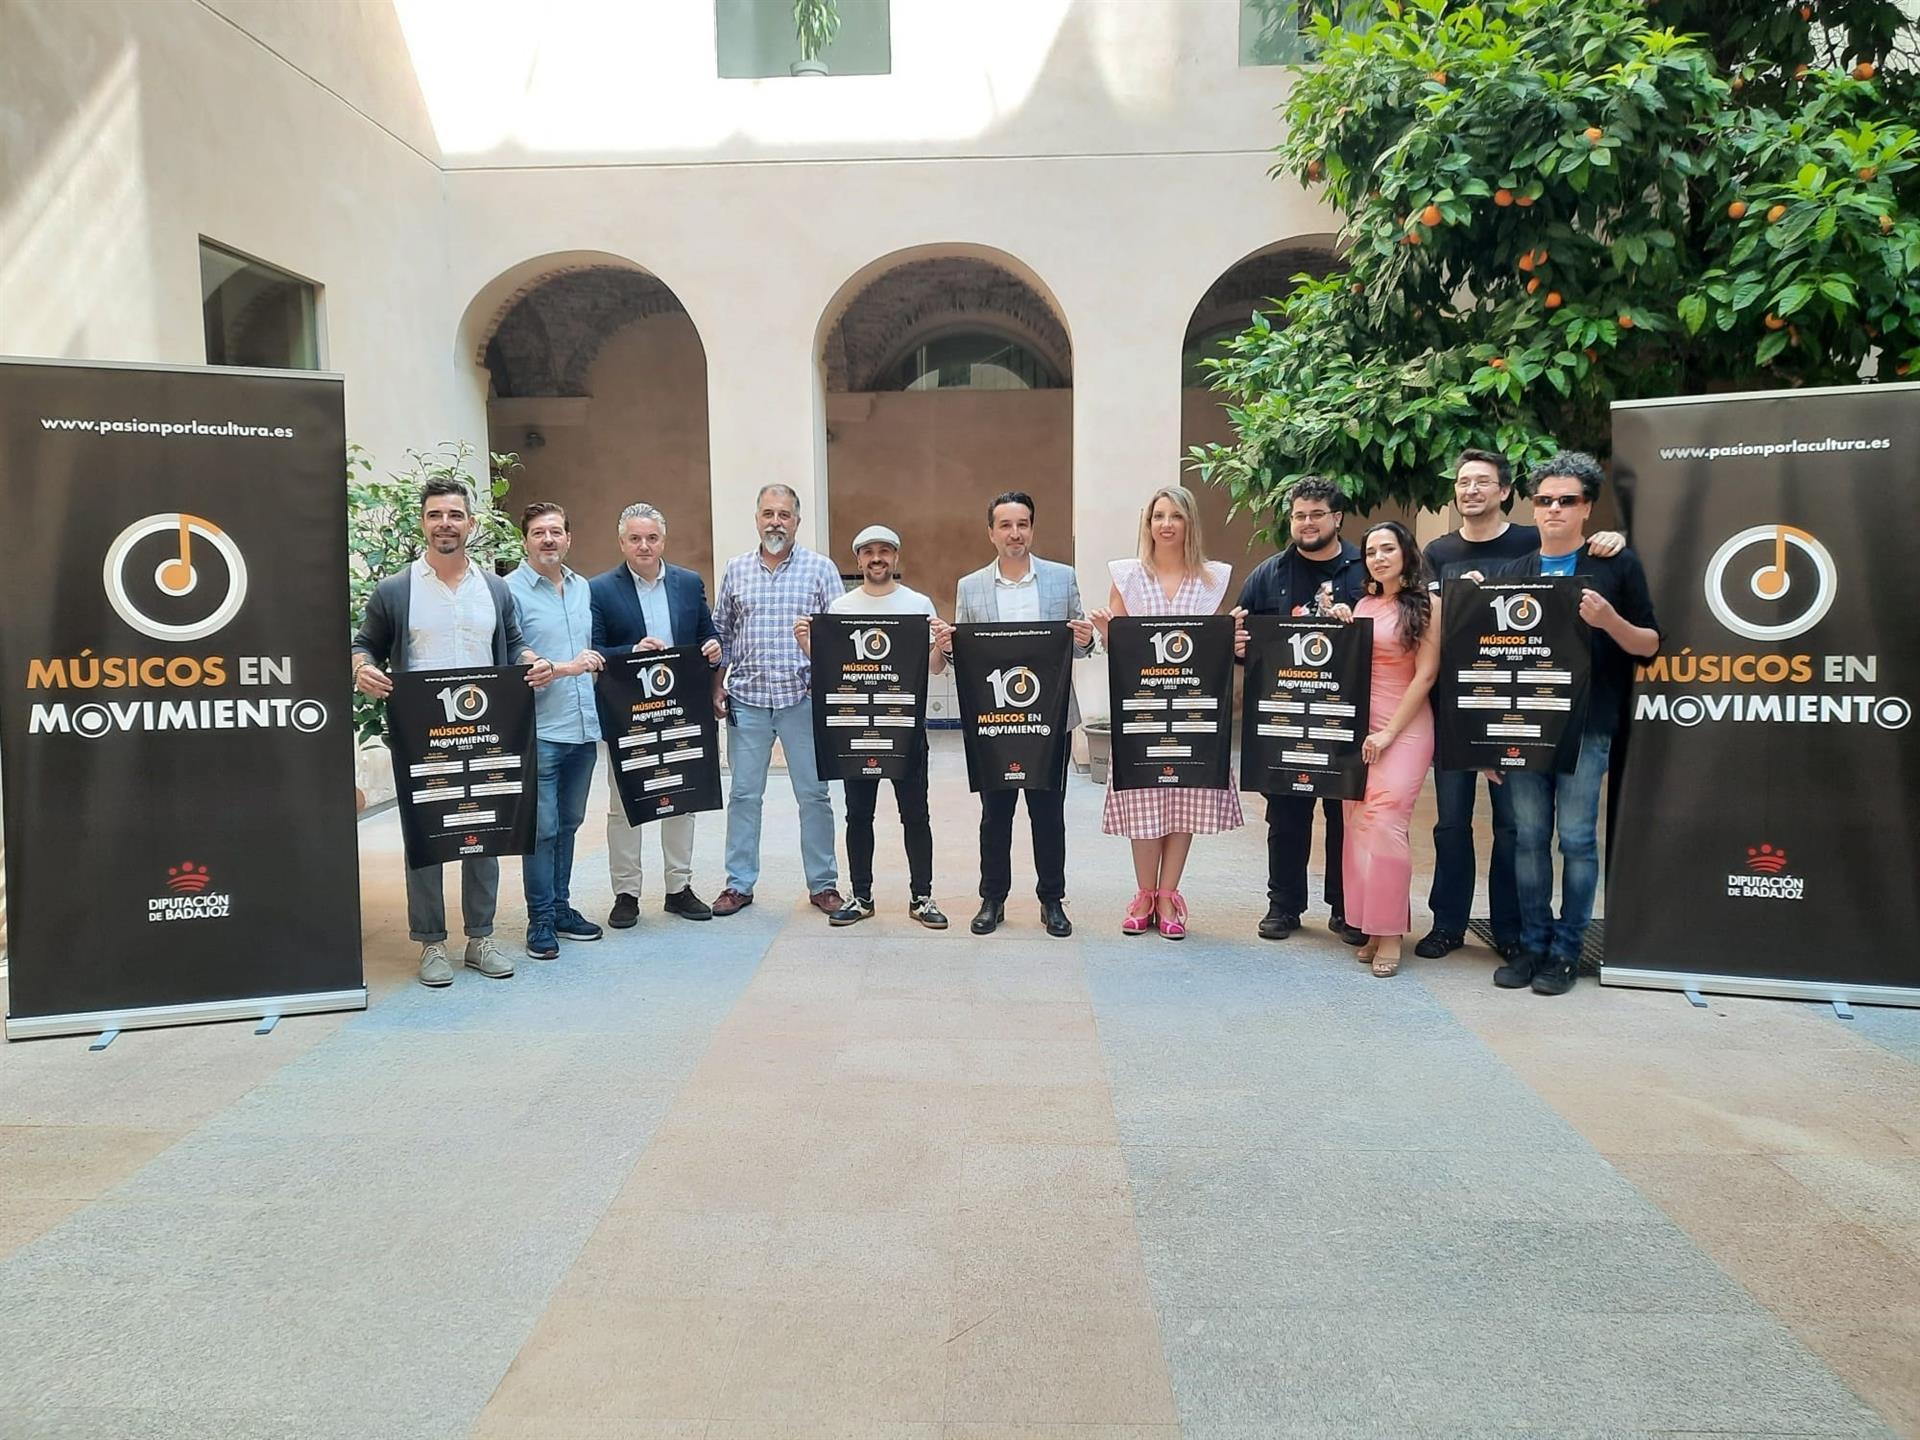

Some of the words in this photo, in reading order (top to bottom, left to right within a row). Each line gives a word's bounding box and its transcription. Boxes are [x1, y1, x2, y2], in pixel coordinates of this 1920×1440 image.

[40, 418, 293, 438] www.pasionporlacultura.es
[1660, 438, 1890, 460] www.pasionporlacultura.es
[1479, 634, 1526, 645] MÚSICOS
[1528, 636, 1542, 644] EN
[1479, 646, 1551, 657] MOVIMIENTO
[26, 649, 226, 689] MÚSICOS
[239, 656, 292, 685] EN
[842, 662, 879, 672] MÚSICOS
[1635, 647, 1813, 682] MÚSICOS
[1824, 655, 1877, 682] EN
[842, 673, 899, 682] MOVIMIENTO
[1140, 667, 1180, 676] MÚSICOS
[1278, 668, 1319, 679] MÚSICOS
[1320, 671, 1332, 679] EN
[1140, 677, 1200, 687] MOVIMIENTO
[1277, 680, 1340, 692] MOVIMIENTO
[632, 700, 666, 713] MÚSICOS
[667, 699, 676, 707] EN
[1634, 694, 1912, 730] MOVIMIENTO
[29, 698, 328, 738] MOVIMIENTO
[632, 707, 684, 722] MOVIMIENTO
[978, 712, 1025, 723] MÚSICOS
[1028, 713, 1042, 722] EN
[429, 725, 475, 737] MÚSICOS
[477, 724, 490, 733] EN
[978, 725, 1050, 737] MOVIMIENTO
[430, 734, 499, 748] MOVIMIENTO
[1728, 875, 1804, 889] DIPUTACIÓN
[1728, 887, 1741, 896] DE
[1743, 886, 1804, 899] BADAJOZ
[149, 892, 229, 910] DIPUTACIÓN
[149, 912, 162, 922] DE
[165, 906, 230, 920] BADAJOZ
